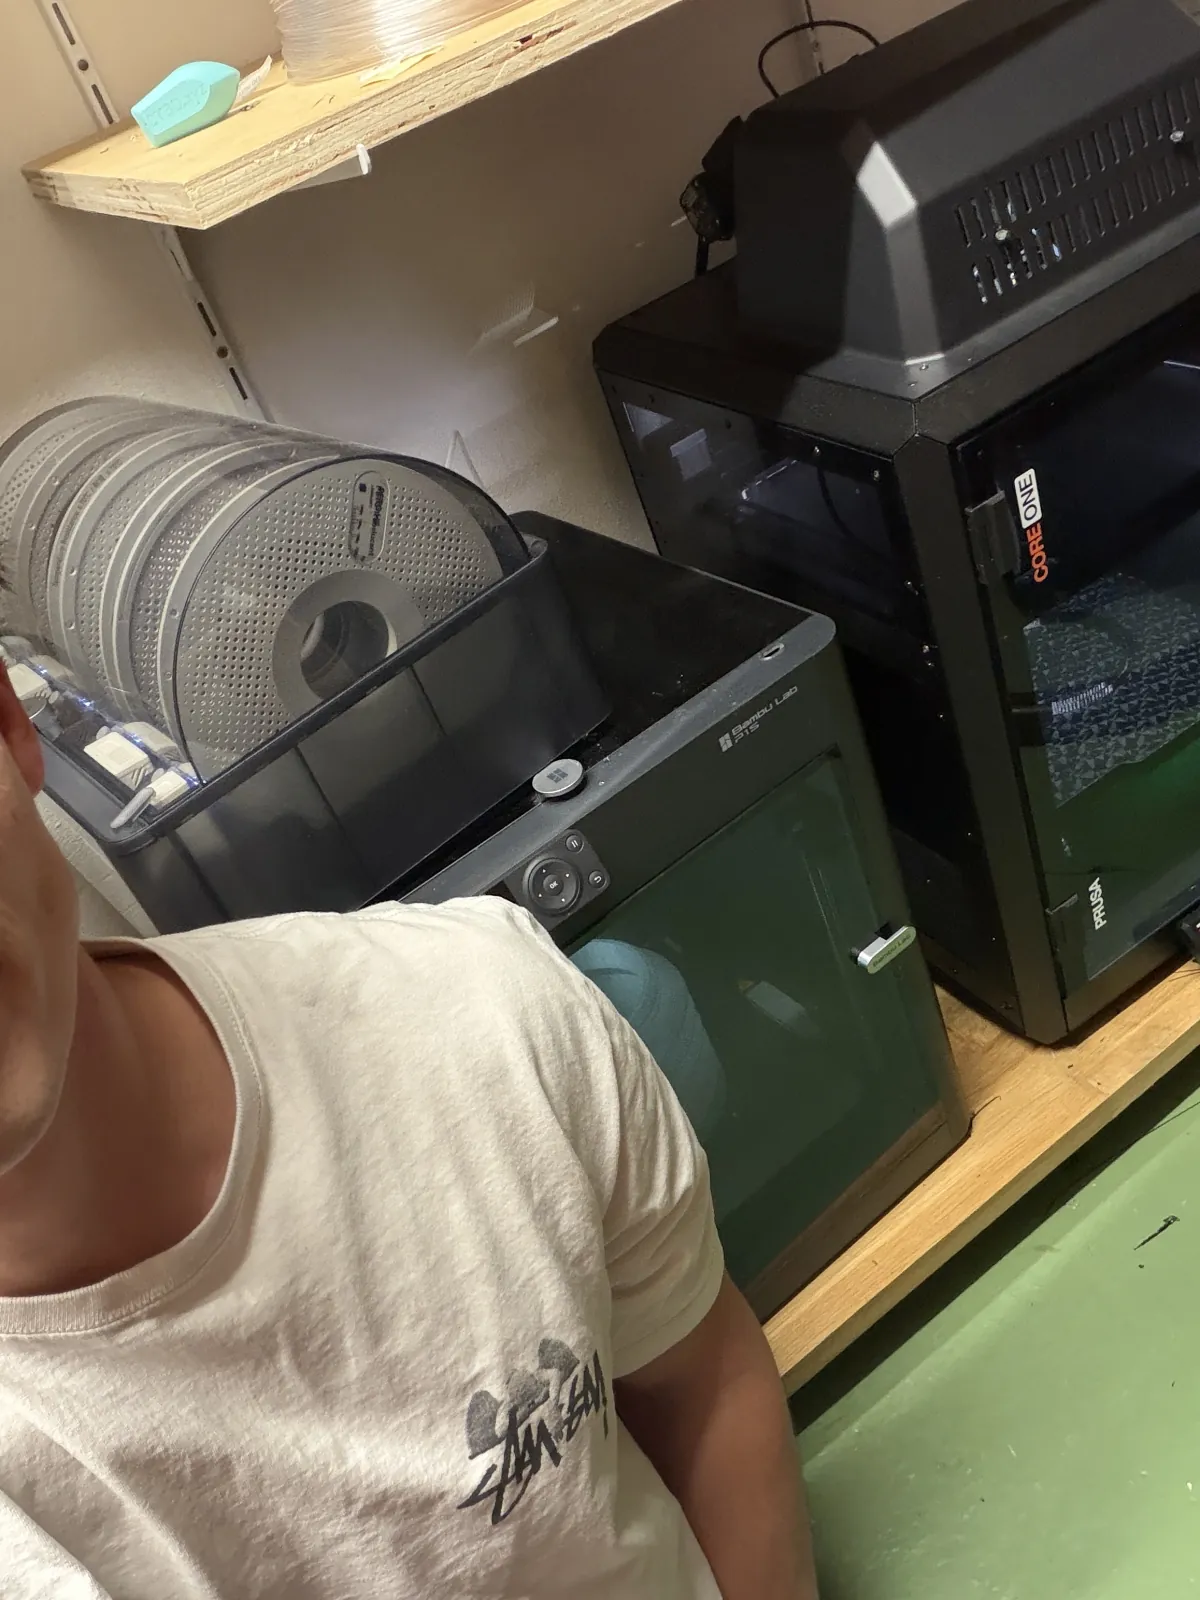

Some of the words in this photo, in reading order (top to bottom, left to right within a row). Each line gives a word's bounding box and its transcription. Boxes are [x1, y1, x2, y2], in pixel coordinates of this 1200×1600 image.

[1019, 474, 1037, 521] ONE
[1027, 523, 1048, 582] CORE
[731, 703, 773, 736] Bambu
[775, 686, 798, 705] Lab
[734, 721, 759, 743] P1S
[549, 881, 558, 889] OK
[1088, 877, 1107, 930] PRUSA
